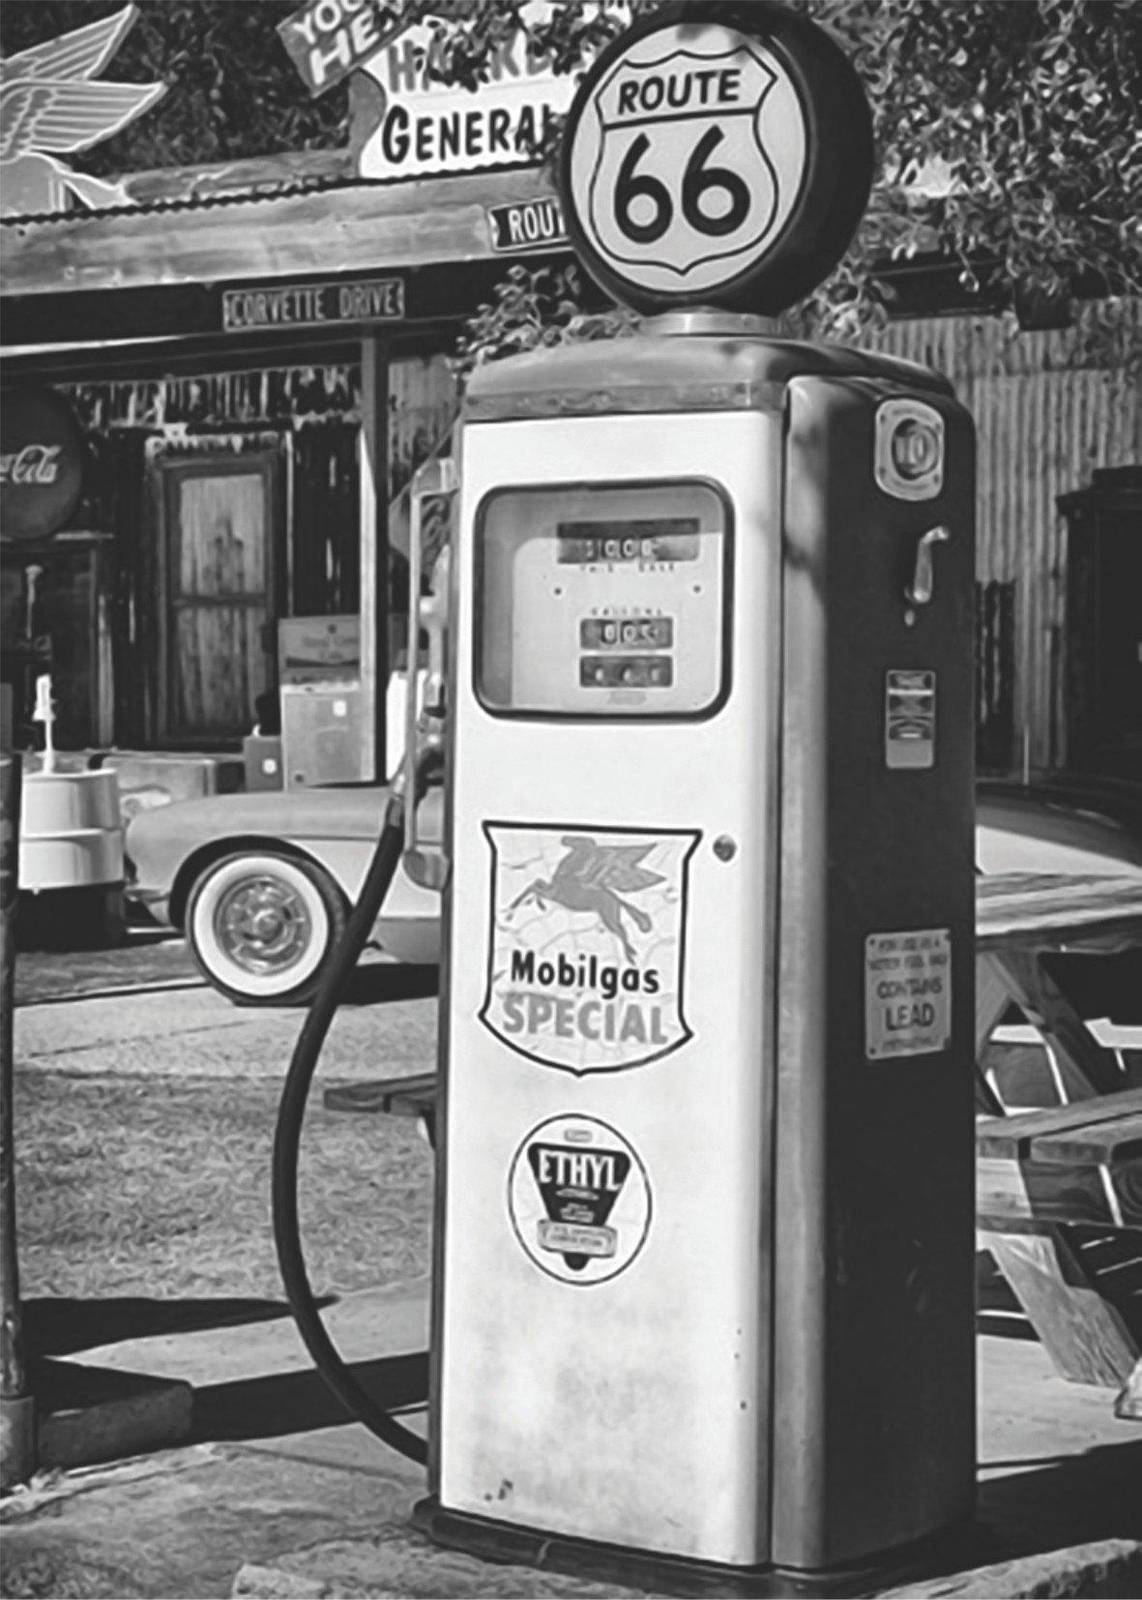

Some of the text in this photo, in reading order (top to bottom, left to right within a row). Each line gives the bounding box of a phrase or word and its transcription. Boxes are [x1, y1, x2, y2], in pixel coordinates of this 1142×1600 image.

[310, 7, 393, 85] HE
[618, 69, 742, 116] ROUTE
[614, 124, 751, 245] 66
[231, 284, 395, 326] CORVETTE DRIVE
[511, 950, 659, 1000] Mobilgas
[502, 995, 668, 1045] SPECIAL
[885, 1002, 935, 1031] LEAD
[538, 1149, 624, 1191] ETHYL
